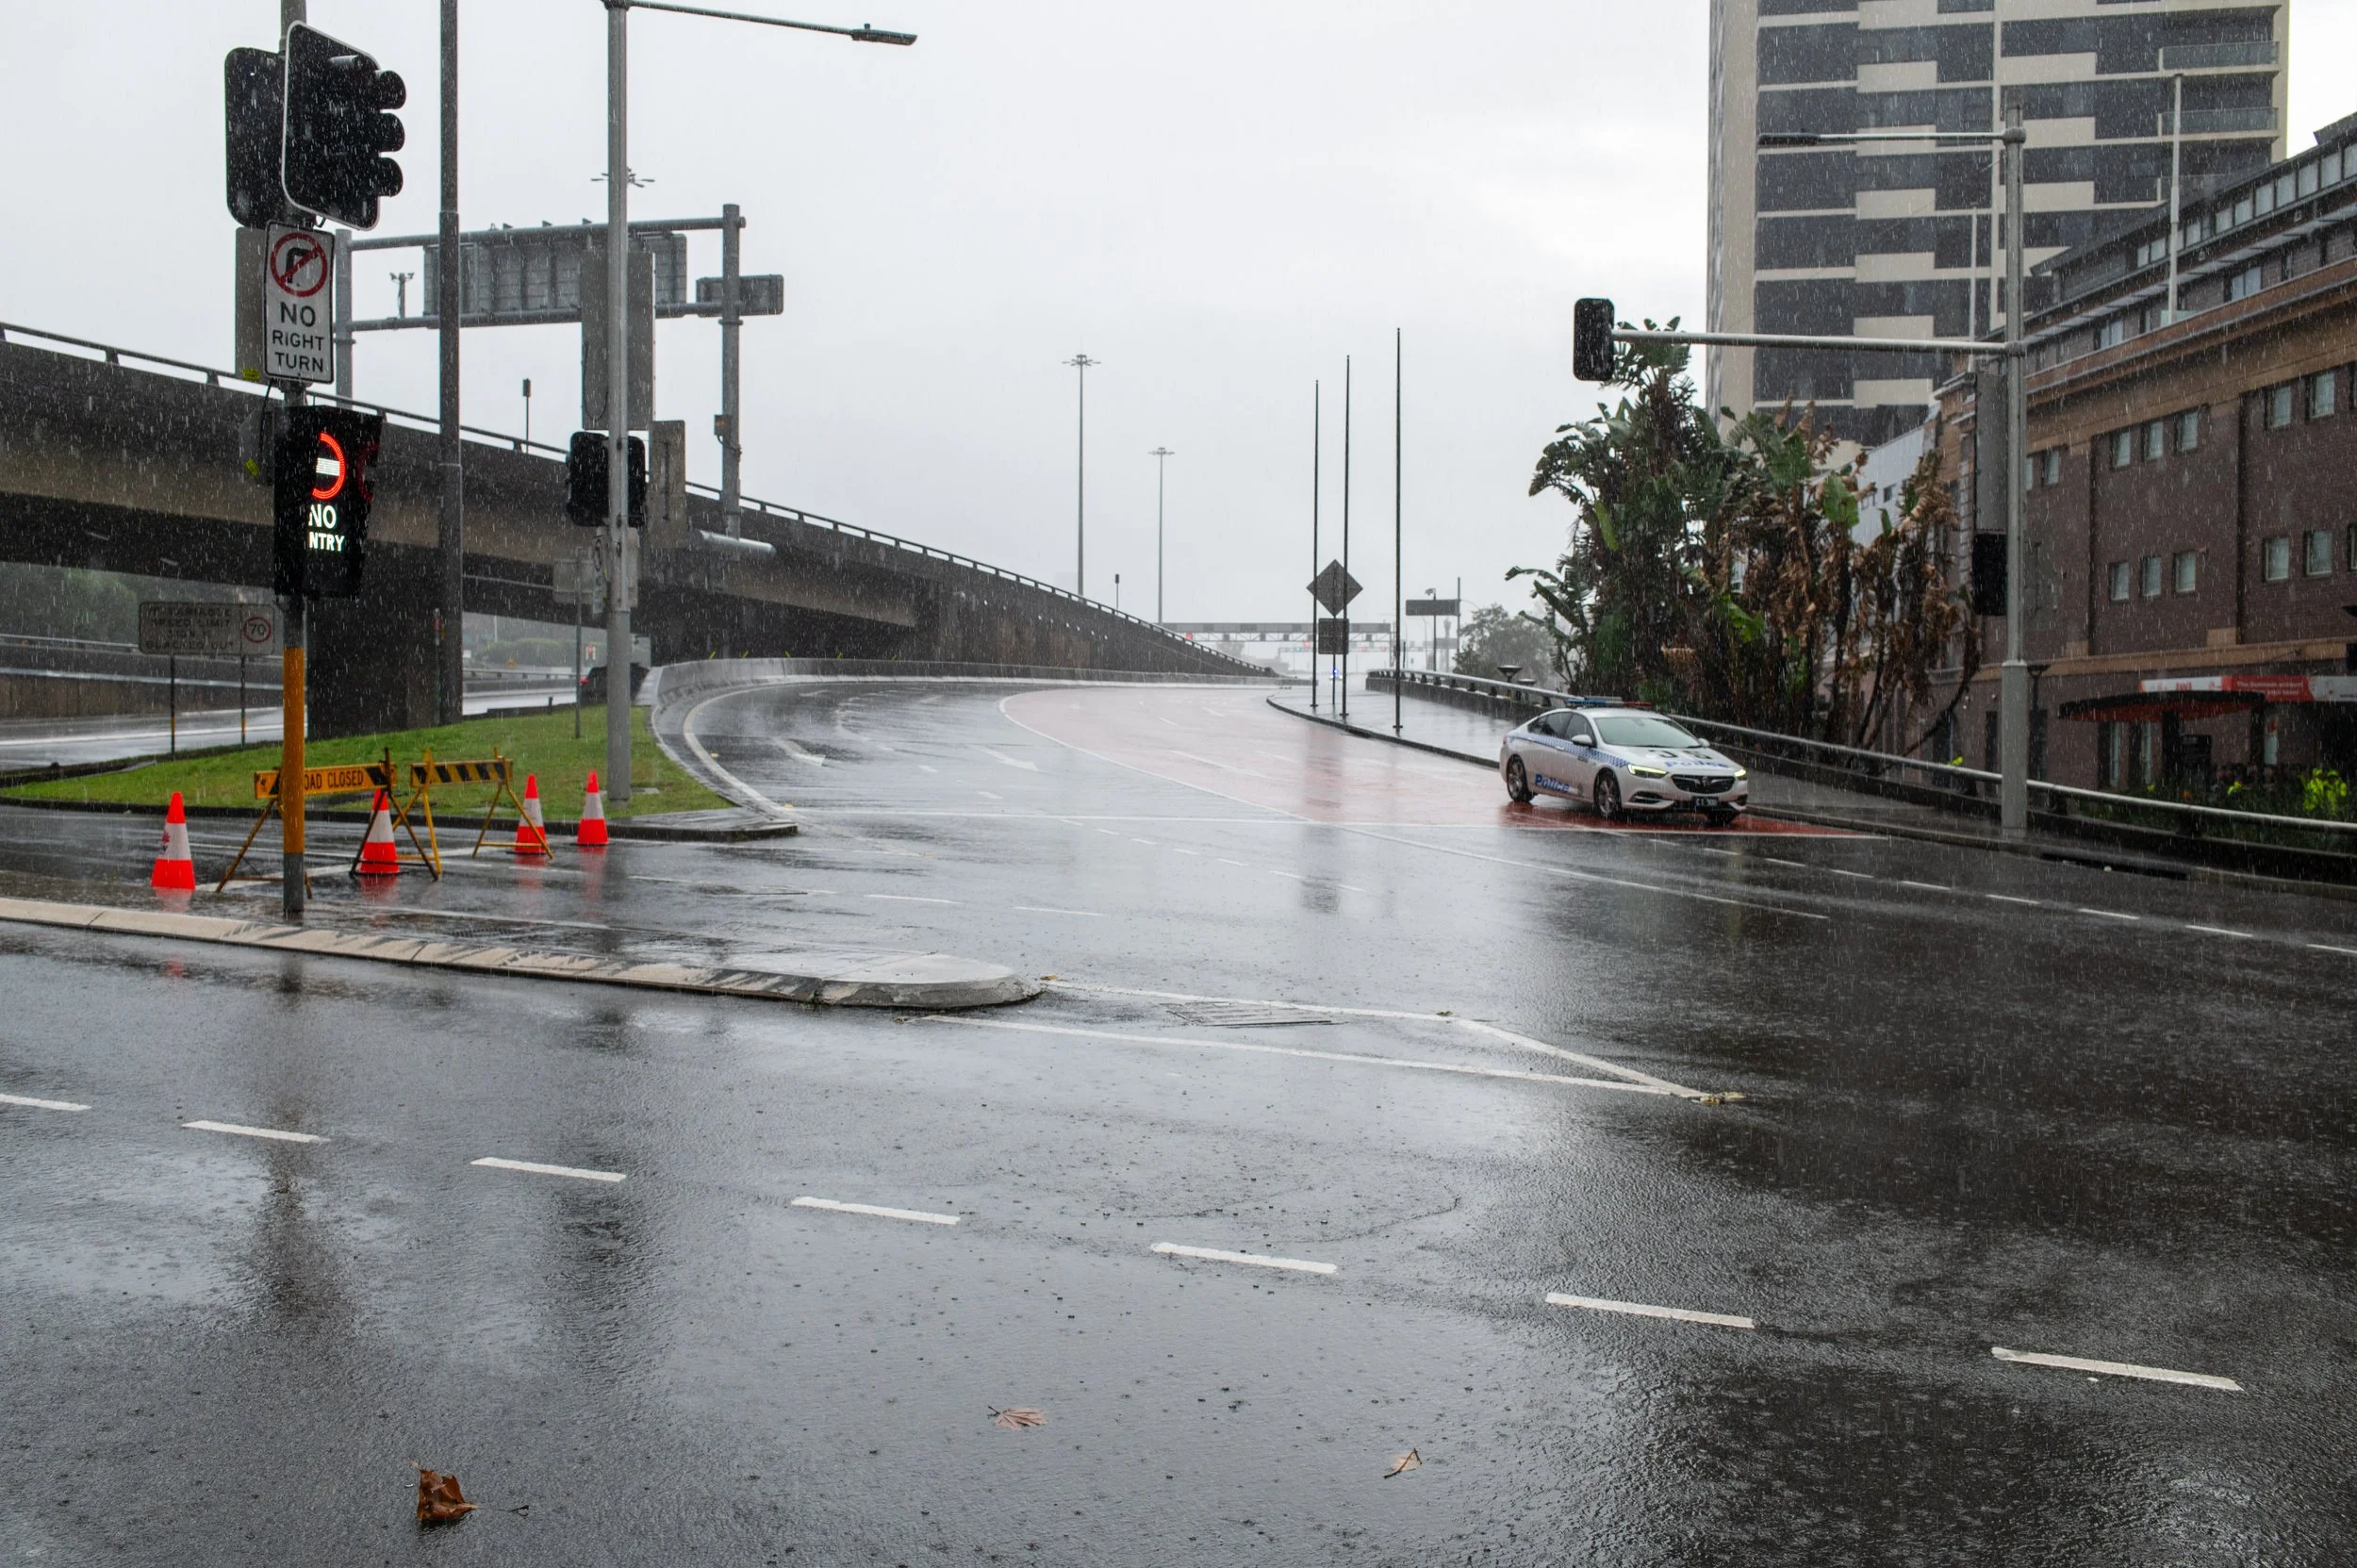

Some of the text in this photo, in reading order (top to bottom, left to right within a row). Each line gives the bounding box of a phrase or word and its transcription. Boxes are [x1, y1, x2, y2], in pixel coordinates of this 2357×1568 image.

[280, 301, 316, 328] NO
[272, 329, 324, 352] RIGHT
[274, 352, 323, 372] TURN
[308, 503, 338, 529] NO
[308, 531, 345, 552] NTRY
[248, 622, 267, 636] 70
[305, 769, 364, 790] OAD CLOSED
[1534, 773, 1570, 793] Police
